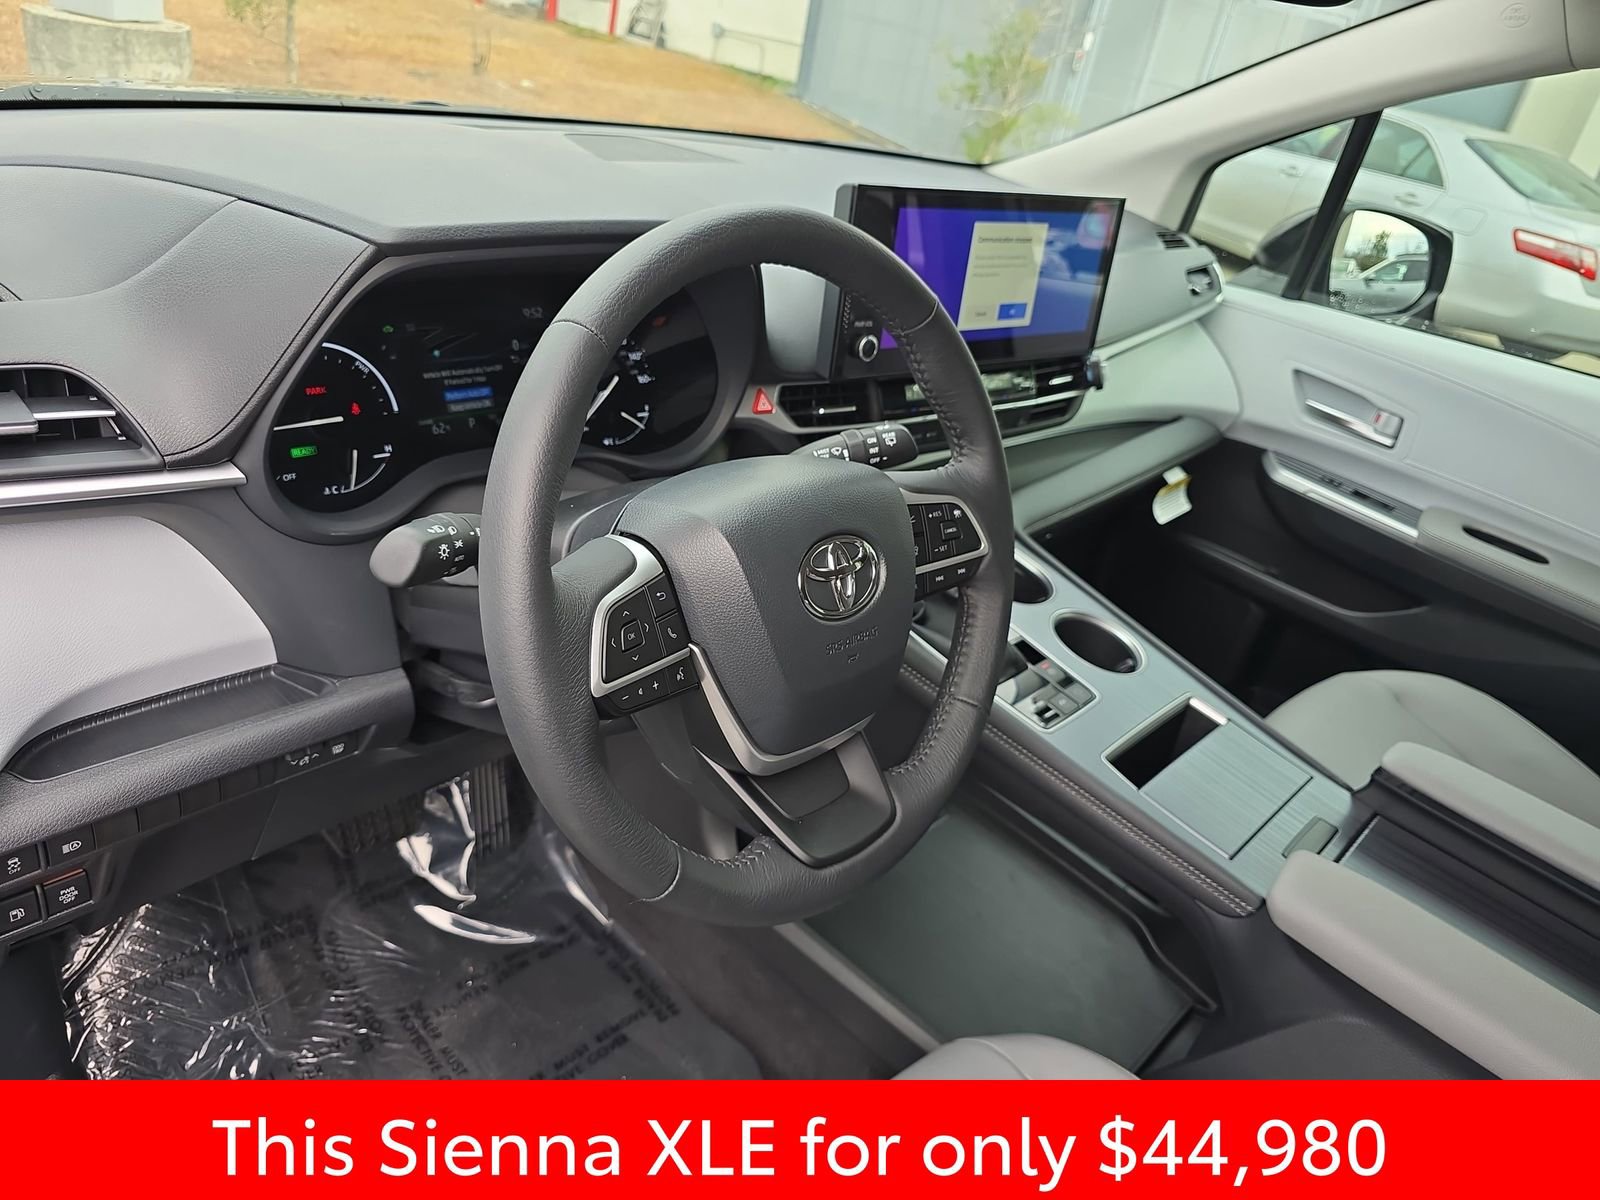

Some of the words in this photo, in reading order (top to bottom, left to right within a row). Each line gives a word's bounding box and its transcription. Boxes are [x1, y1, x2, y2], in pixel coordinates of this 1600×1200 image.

[355, 361, 370, 374] PWR
[305, 386, 327, 395] PARK
[866, 437, 877, 445] ON
[291, 446, 318, 458] READY
[868, 446, 879, 454] INT
[869, 456, 881, 465] OFF
[282, 473, 297, 482] OFF
[332, 485, 339, 495] C
[627, 632, 636, 640] OK
[8, 866, 21, 875] OFF
[60, 886, 75, 895] PWR
[59, 890, 78, 901] DOOR
[63, 896, 75, 904] OFF
[554, 1043, 589, 1070] MUST
[595, 1008, 647, 1043] REMOVE
[586, 1033, 629, 1064] COVER
[440, 1046, 468, 1075] MUST
